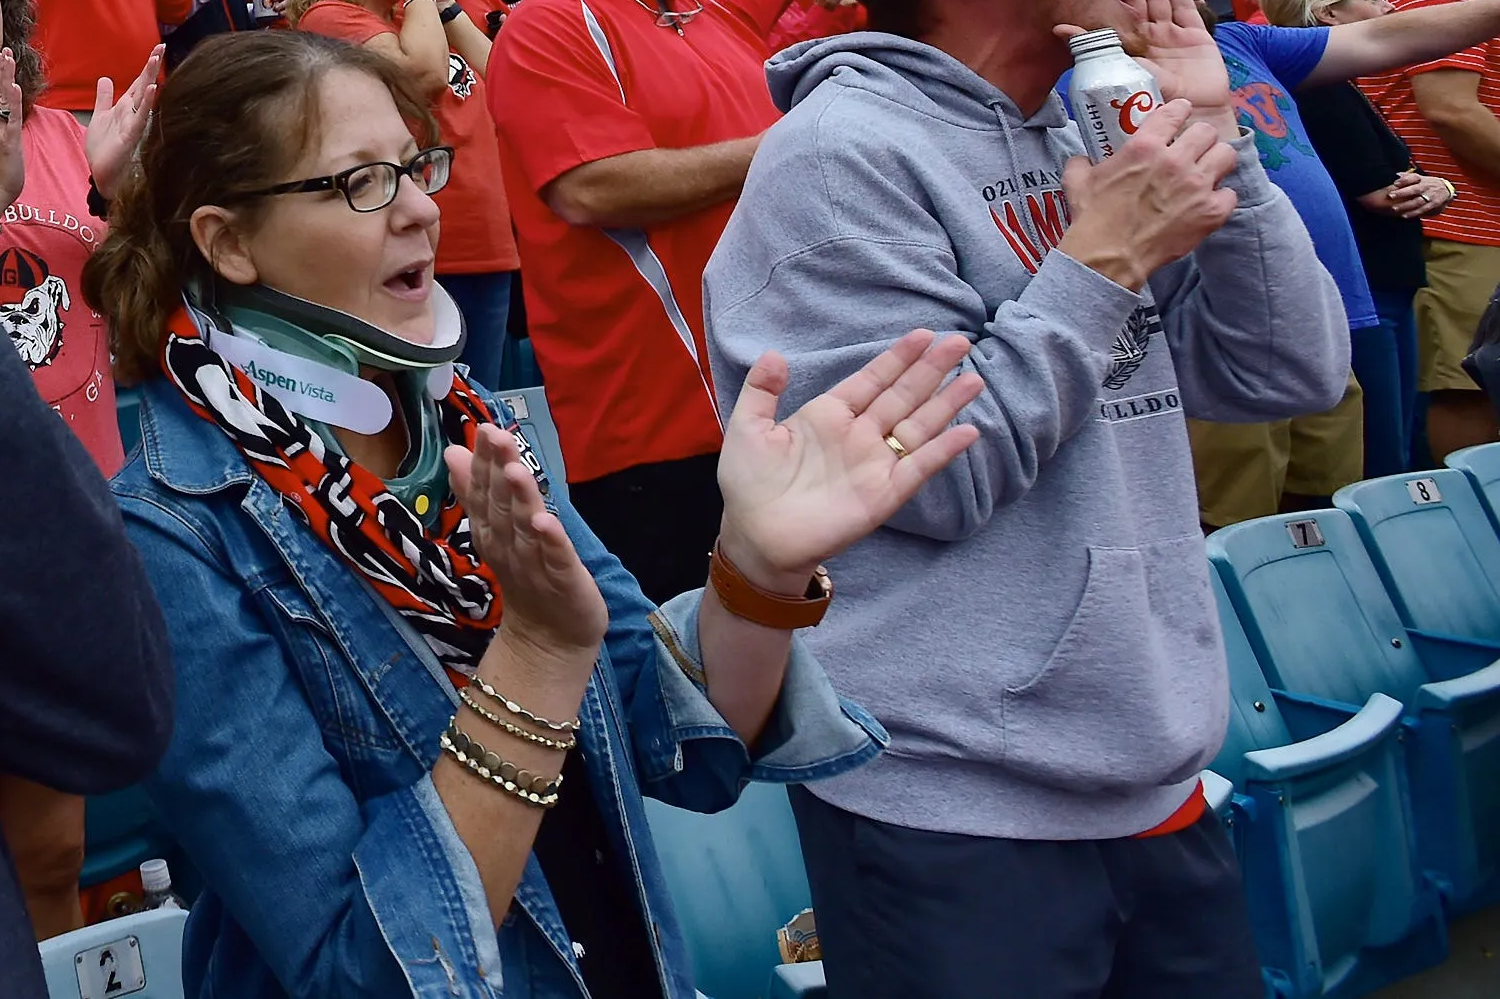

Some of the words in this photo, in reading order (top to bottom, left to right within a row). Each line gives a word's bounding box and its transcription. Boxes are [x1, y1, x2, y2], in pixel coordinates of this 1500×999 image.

[246, 359, 297, 392] Aspen
[300, 381, 335, 403] Vista
[1416, 481, 1431, 502] 8
[99, 949, 122, 995] 2
